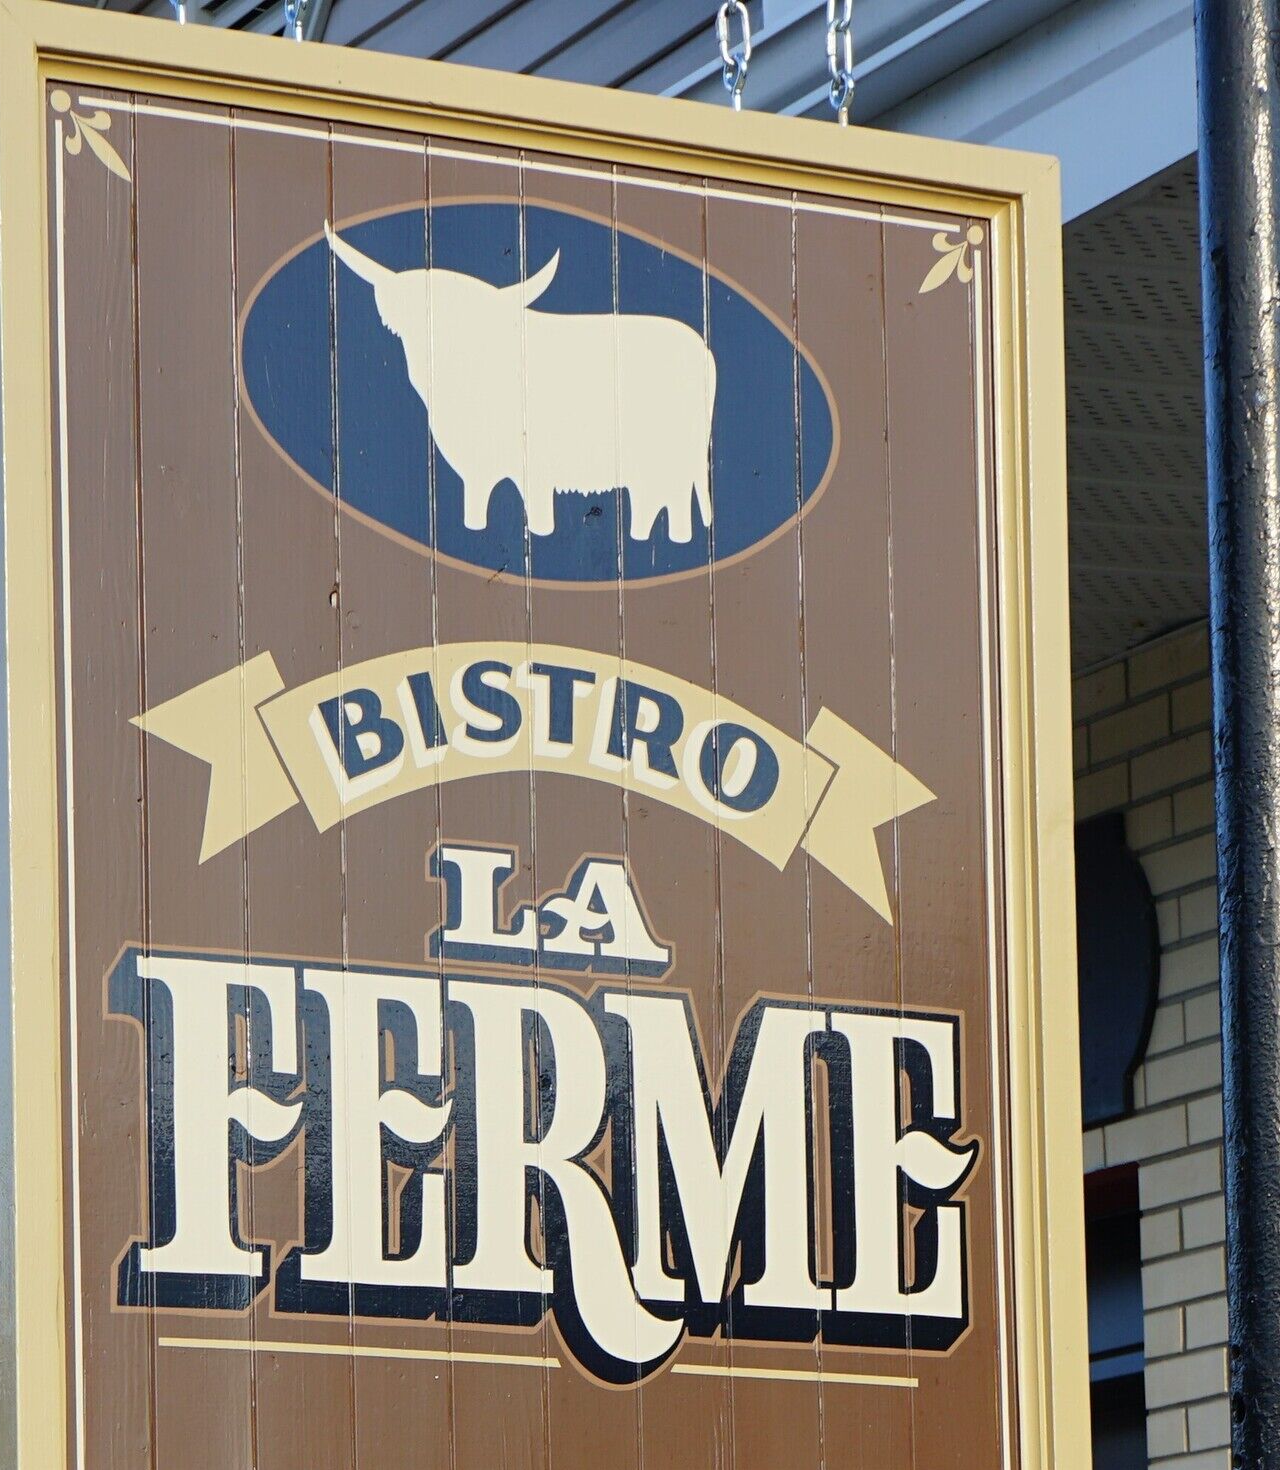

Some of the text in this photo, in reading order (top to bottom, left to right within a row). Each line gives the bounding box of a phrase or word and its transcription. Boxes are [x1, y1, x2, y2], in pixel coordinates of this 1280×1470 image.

[312, 660, 781, 818] BISTRO
[434, 846, 671, 968] LA
[118, 950, 980, 1370] FERME
